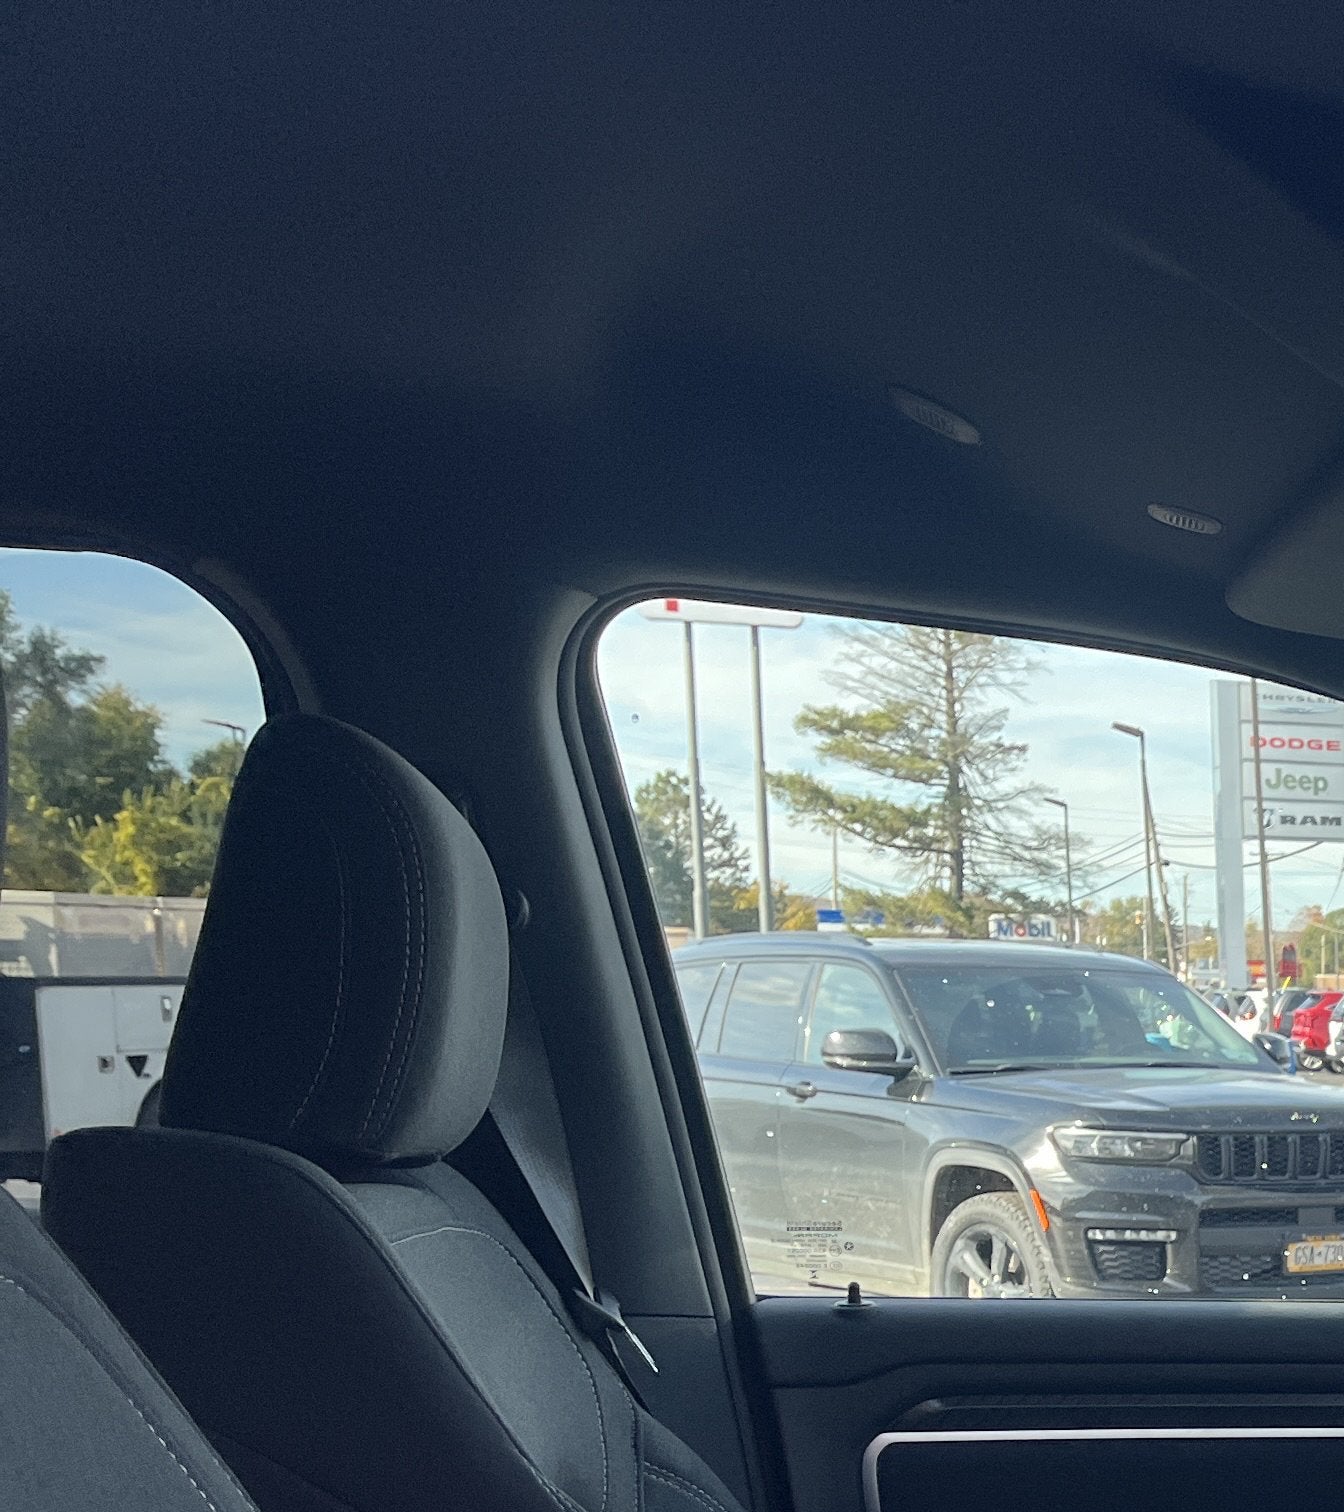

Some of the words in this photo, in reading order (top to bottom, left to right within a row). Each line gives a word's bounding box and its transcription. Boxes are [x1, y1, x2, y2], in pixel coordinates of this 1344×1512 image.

[1250, 736, 1342, 751] DODGE
[1265, 768, 1328, 796] Jeep
[1280, 815, 1342, 826] RAM
[996, 918, 1050, 938] Mobil
